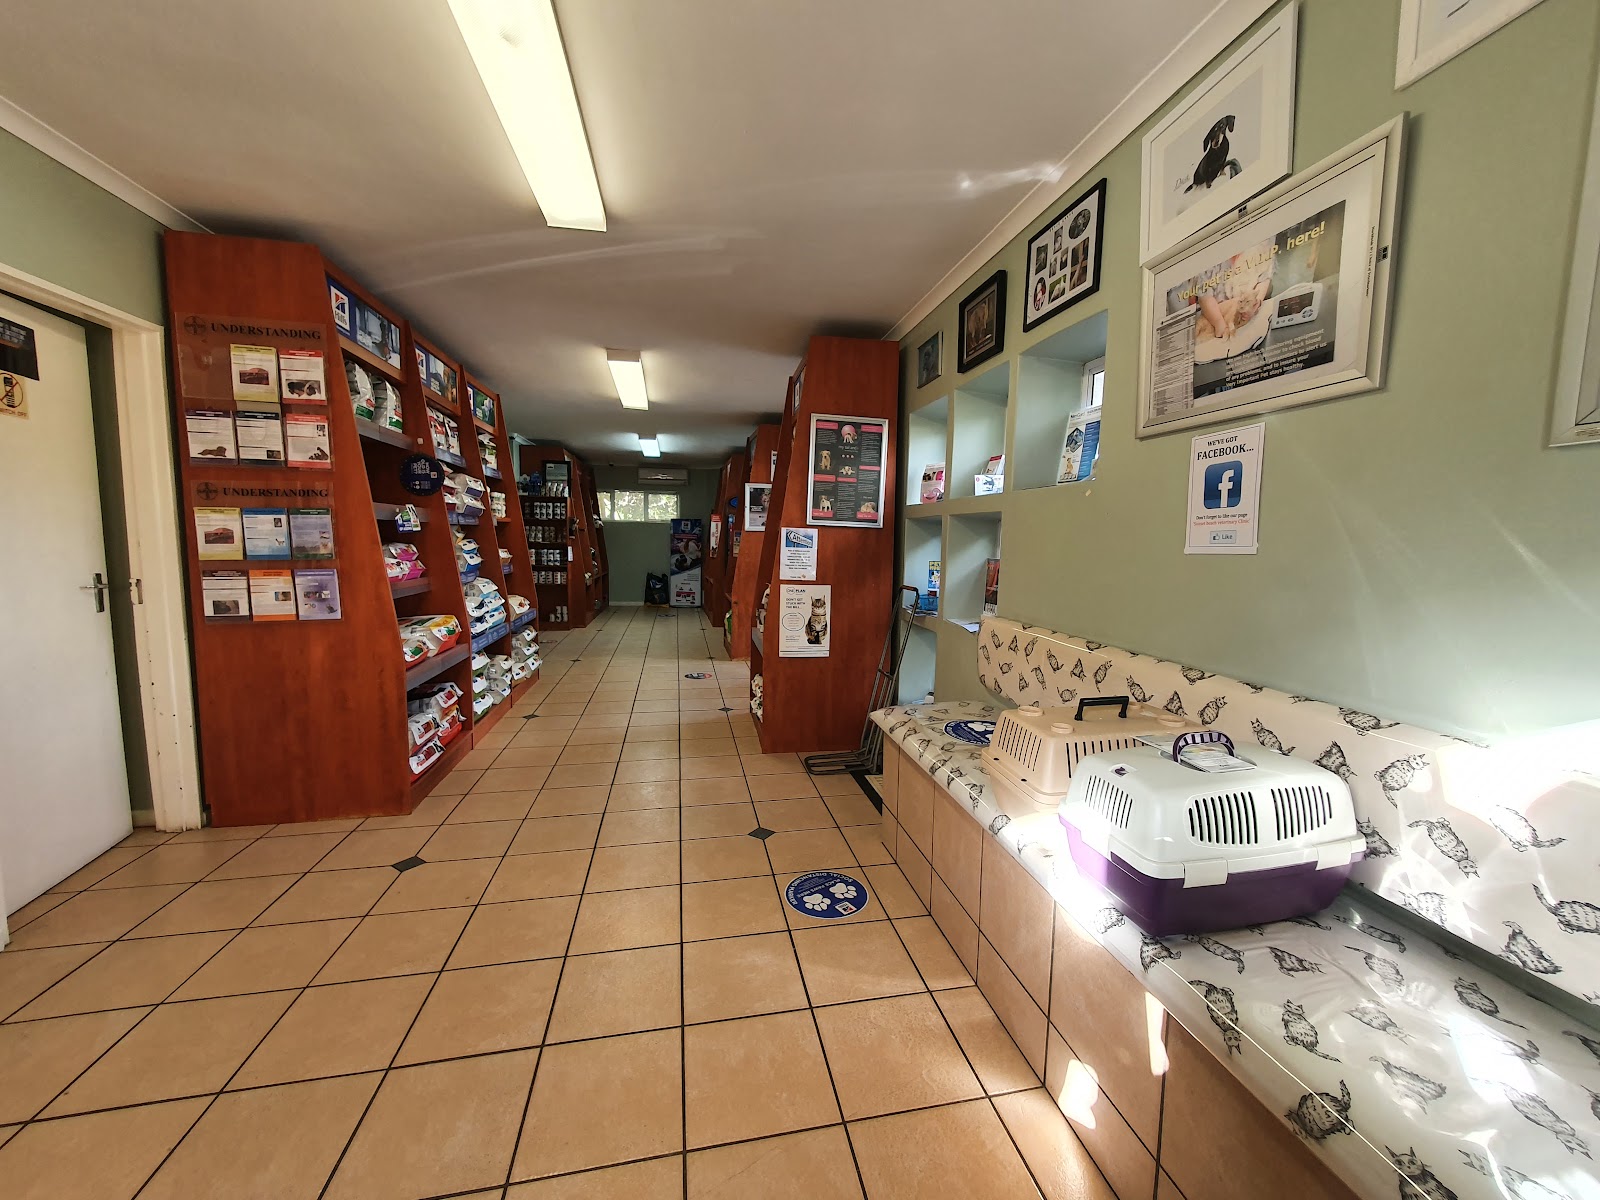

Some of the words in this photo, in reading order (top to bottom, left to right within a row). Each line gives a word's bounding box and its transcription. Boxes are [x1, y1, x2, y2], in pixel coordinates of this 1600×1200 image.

[1177, 285, 1200, 303] Your
[1202, 275, 1221, 293] pet
[1223, 271, 1232, 281] is
[1286, 221, 1326, 250] here!
[211, 322, 321, 340] UNDERSTANDING
[1294, 328, 1324, 343] equipment
[1289, 341, 1304, 350] check
[1305, 336, 1321, 345] blood
[1304, 345, 1318, 353] alert
[1207, 438, 1224, 446] WE'VE
[1225, 435, 1238, 443] GOT
[1197, 443, 1254, 460] FACEBOOK...
[223, 487, 329, 498] UNDERSTANDING
[791, 872, 828, 887] DISTANCING
[829, 872, 854, 882] SOCIAL
